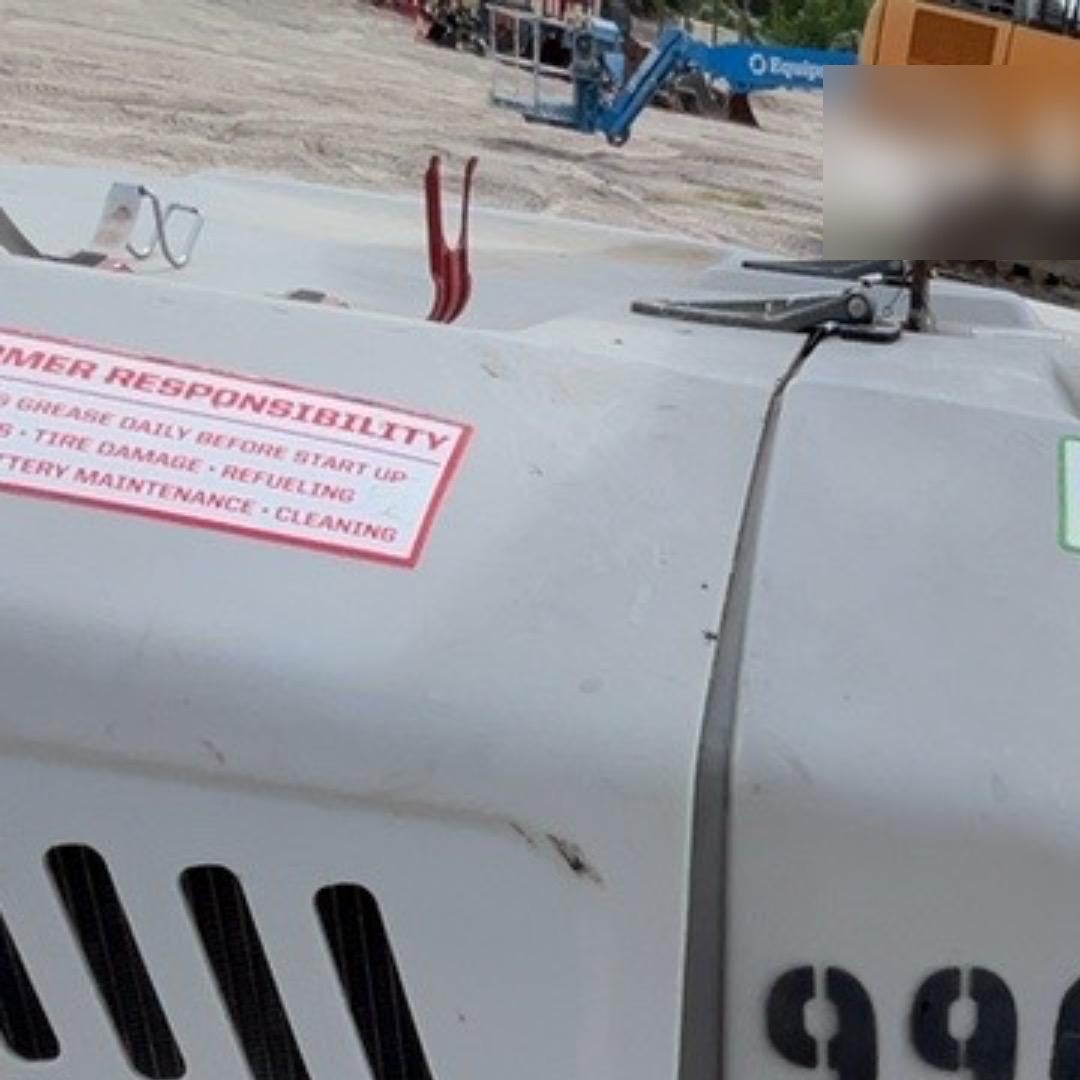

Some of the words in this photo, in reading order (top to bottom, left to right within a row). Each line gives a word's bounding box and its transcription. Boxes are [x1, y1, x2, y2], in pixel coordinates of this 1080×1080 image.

[0, 344, 98, 380] MER
[104, 365, 449, 450] RESPONSIBILITY
[17, 396, 116, 426] GREASE
[119, 415, 191, 440] DAILY
[195, 430, 290, 460] BEFORE
[292, 450, 369, 476] START
[374, 466, 408, 484] UP
[35, 428, 94, 451] TIRE
[97, 440, 203, 473] DAMAGE
[220, 464, 356, 503] REFUELING
[73, 466, 256, 514] MAINTENANCE
[274, 505, 398, 543] CLEANING
